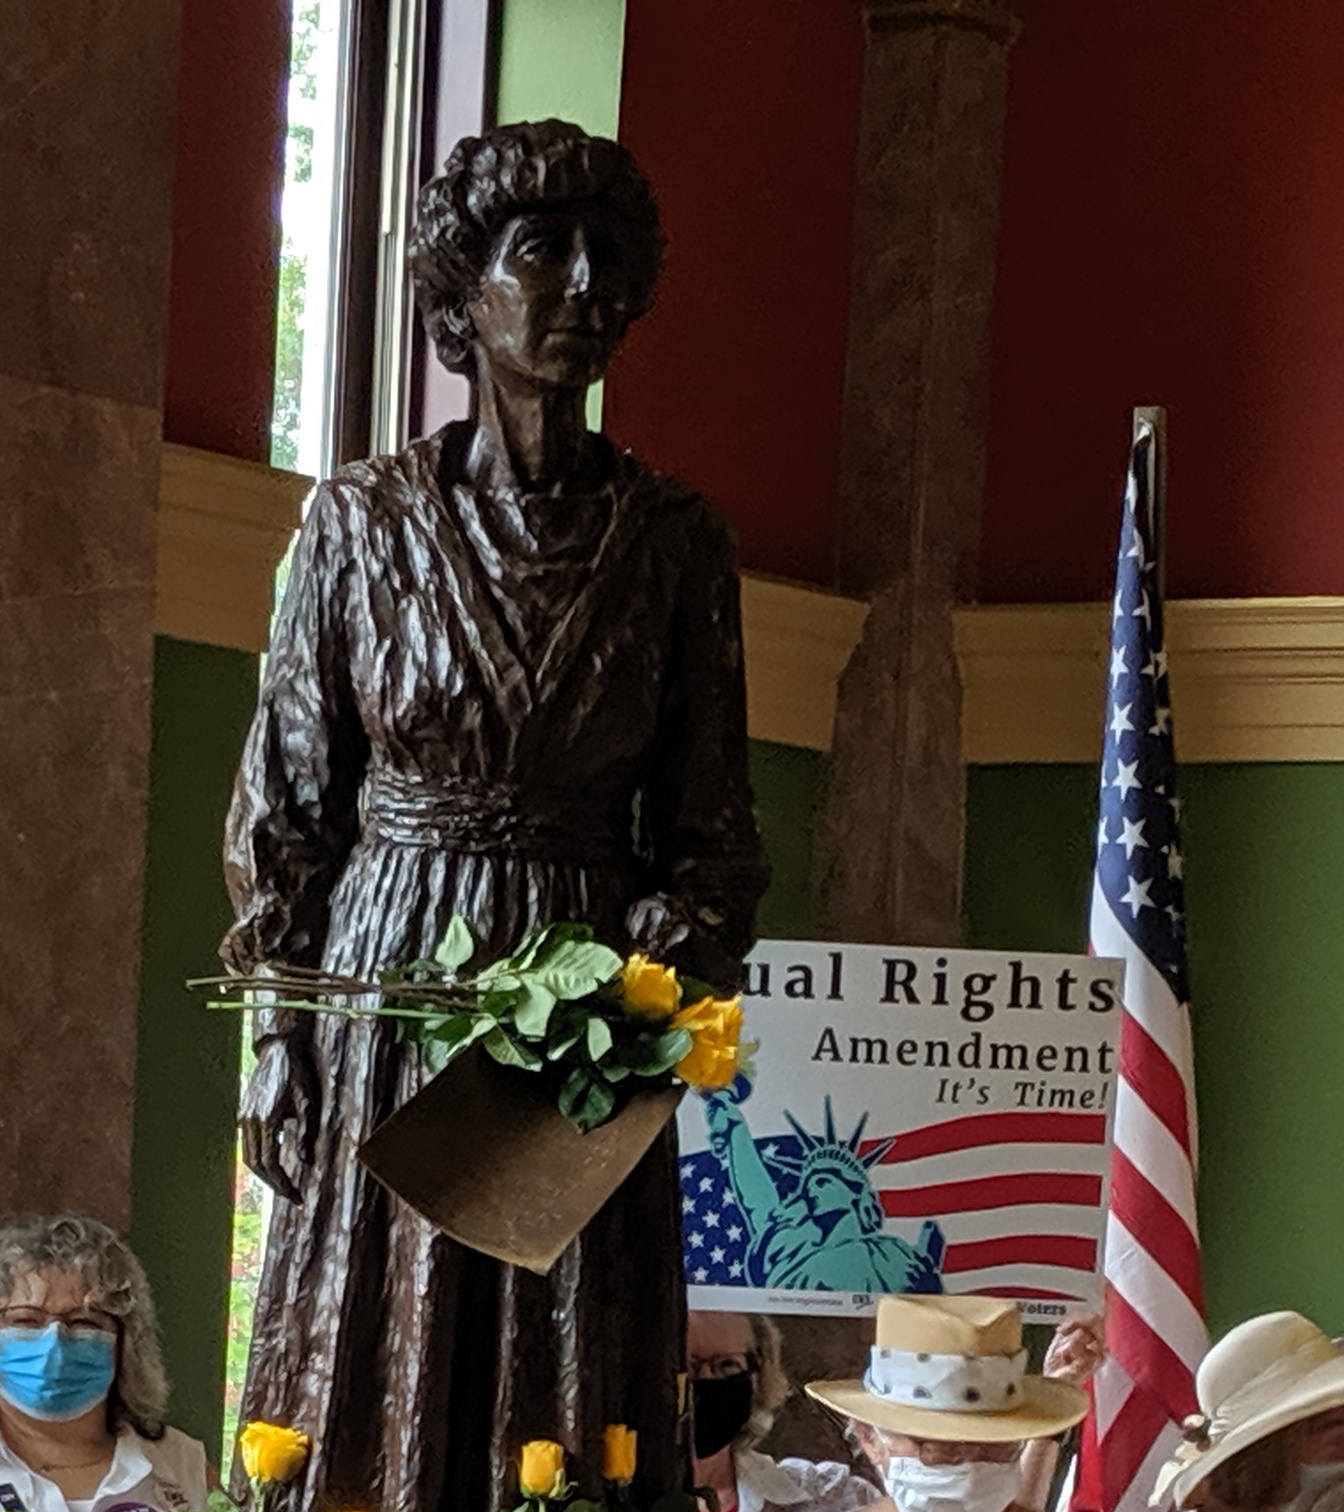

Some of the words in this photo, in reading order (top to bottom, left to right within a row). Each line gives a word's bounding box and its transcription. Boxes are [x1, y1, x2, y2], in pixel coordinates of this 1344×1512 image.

[743, 952, 845, 1000] ual
[880, 957, 1117, 1022] Rights
[811, 1027, 1115, 1073] Amendment
[935, 1078, 991, 1106] It's
[1014, 1081, 1109, 1110] Time!
